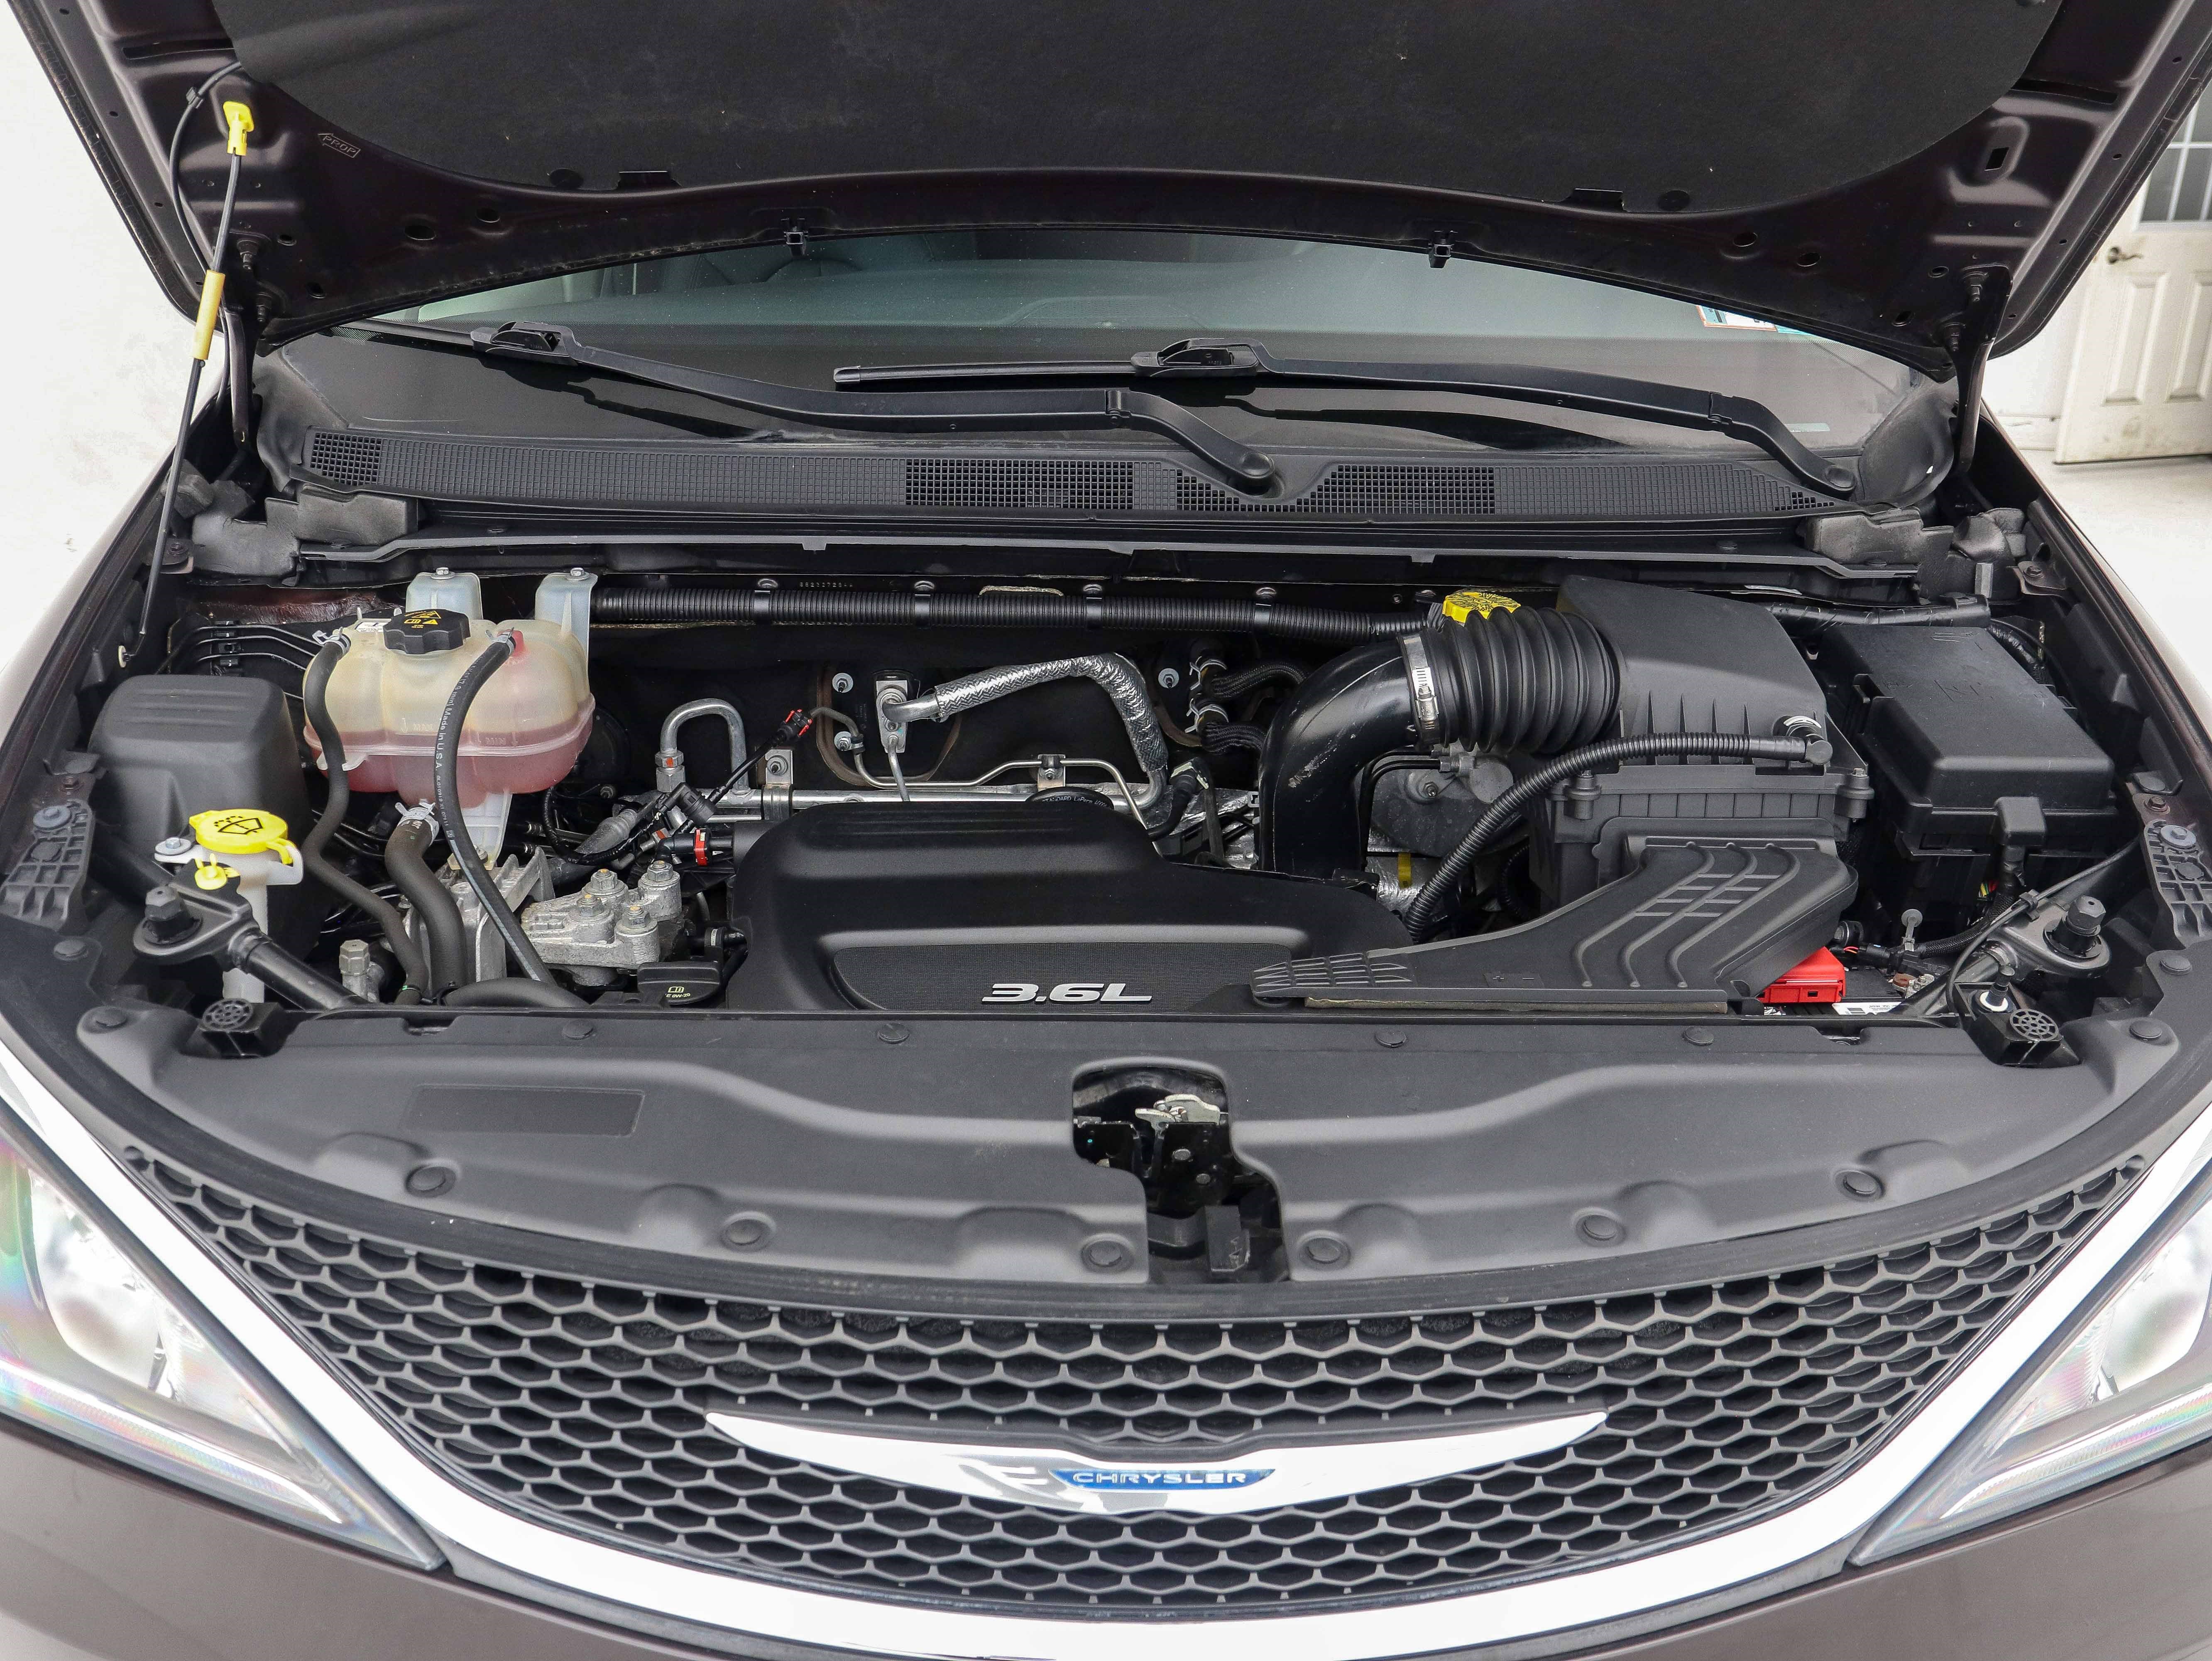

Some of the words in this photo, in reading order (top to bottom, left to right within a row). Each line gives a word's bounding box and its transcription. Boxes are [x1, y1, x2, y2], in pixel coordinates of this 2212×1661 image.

[322, 135, 356, 154] PROP
[440, 708, 453, 730] Made
[982, 983, 1152, 1002] 3.6L
[1072, 1472, 1247, 1484] CHRYSLER
